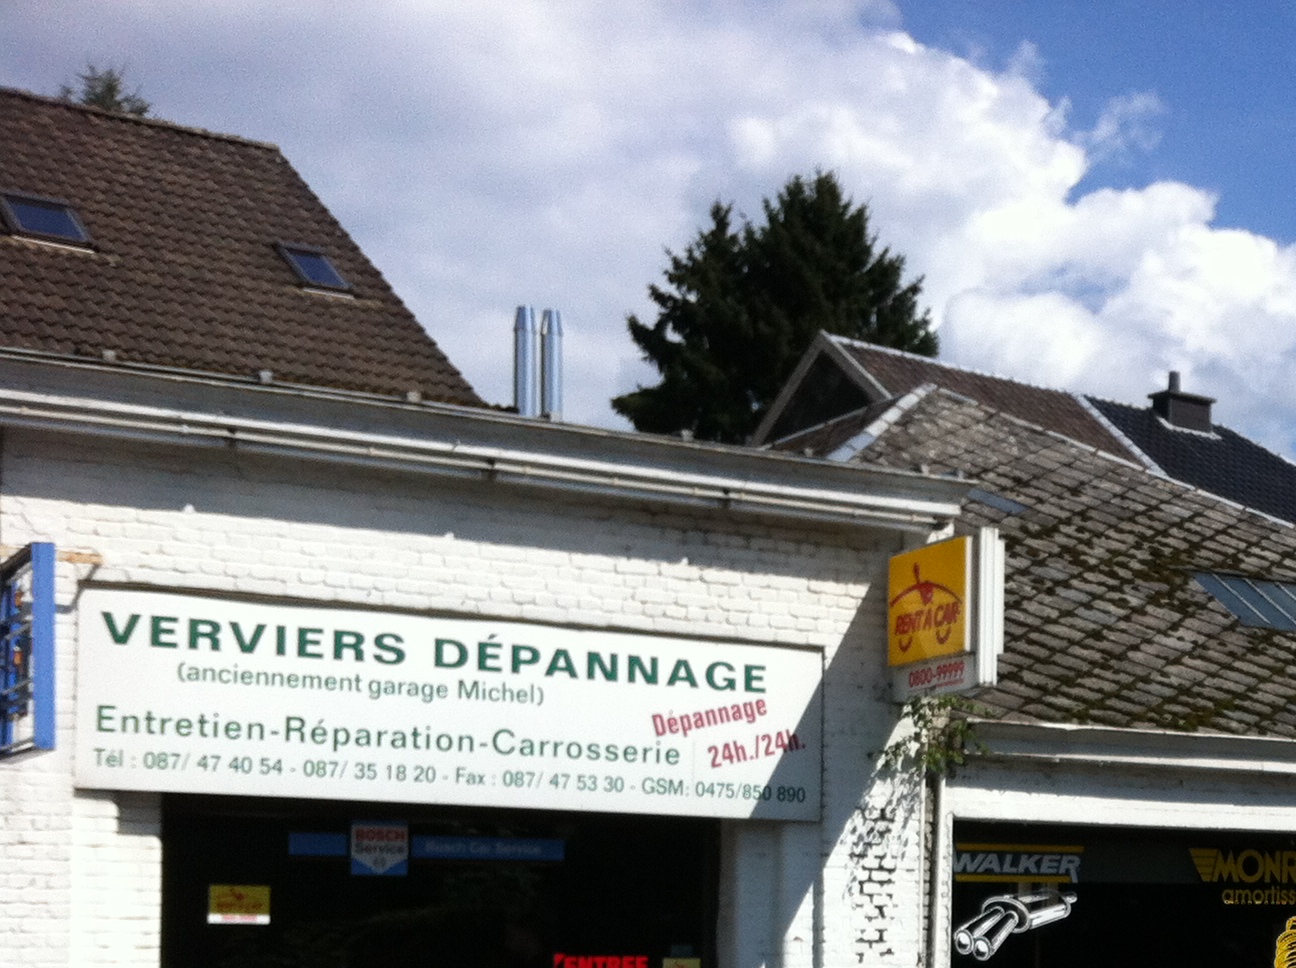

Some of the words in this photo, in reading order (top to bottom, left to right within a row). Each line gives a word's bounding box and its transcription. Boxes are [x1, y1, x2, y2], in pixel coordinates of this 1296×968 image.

[101, 611, 406, 665] VERVIERS
[434, 633, 767, 693] DÉPANNAGE
[177, 662, 363, 693] (anciennement
[368, 678, 449, 703] garage
[457, 680, 545, 706] Michel)
[652, 698, 768, 738] Dépannage
[197, 754, 222, 772] 47
[228, 756, 253, 774] 40
[259, 757, 283, 775] 54
[354, 762, 378, 781] 35
[386, 764, 407, 782] 18
[413, 765, 437, 783] 20
[549, 773, 570, 790] 47
[576, 775, 598, 792] 53
[603, 776, 625, 793] 30
[776, 786, 806, 803] 890
[355, 828, 405, 842] BOSCH
[953, 852, 1082, 884] WALKER
